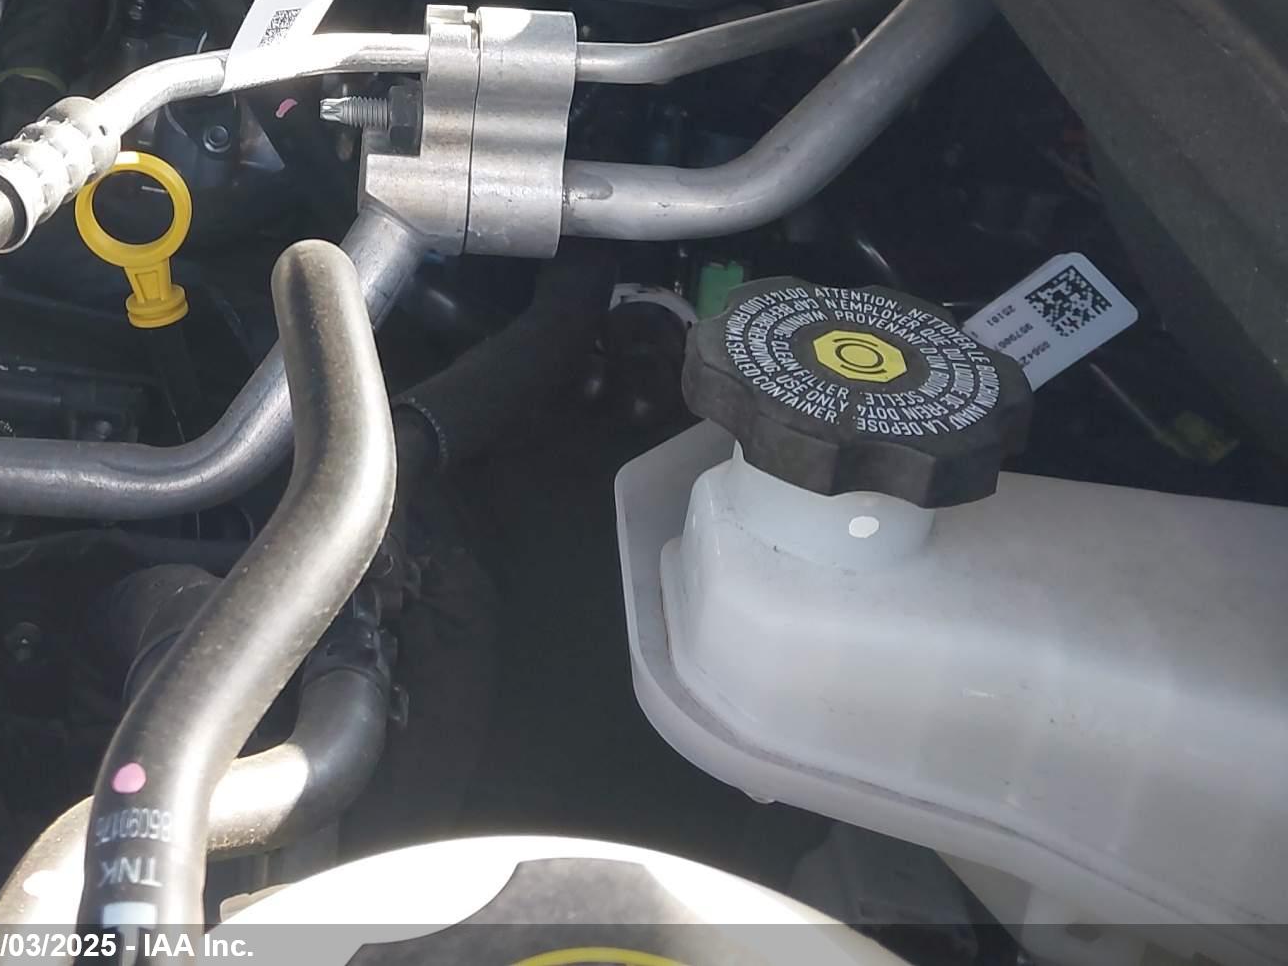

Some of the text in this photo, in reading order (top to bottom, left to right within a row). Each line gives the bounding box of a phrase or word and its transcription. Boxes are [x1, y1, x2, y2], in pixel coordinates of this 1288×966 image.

[738, 293, 777, 315] FLUID
[793, 298, 820, 312] CAP
[725, 310, 751, 335] FROM
[751, 303, 795, 331] BEFORE
[834, 310, 928, 345] PROVENANT
[908, 308, 977, 350] NETTOYER
[919, 328, 951, 346] QUE
[725, 341, 761, 377] SEALED
[942, 348, 967, 361] DU
[968, 351, 991, 363] LE
[771, 340, 803, 371] CLEAN
[793, 369, 849, 400] FILLER
[951, 363, 975, 398] LIQUIDE
[775, 374, 808, 395] USE
[974, 364, 1000, 409] BOUCHON
[752, 375, 840, 425] CONTAINER.
[805, 390, 849, 413] ONLY
[901, 401, 950, 421] FREIN
[939, 393, 965, 410] DE
[921, 418, 950, 435] LA
[948, 403, 988, 430] AVANT
[97, 857, 164, 888] TNK
